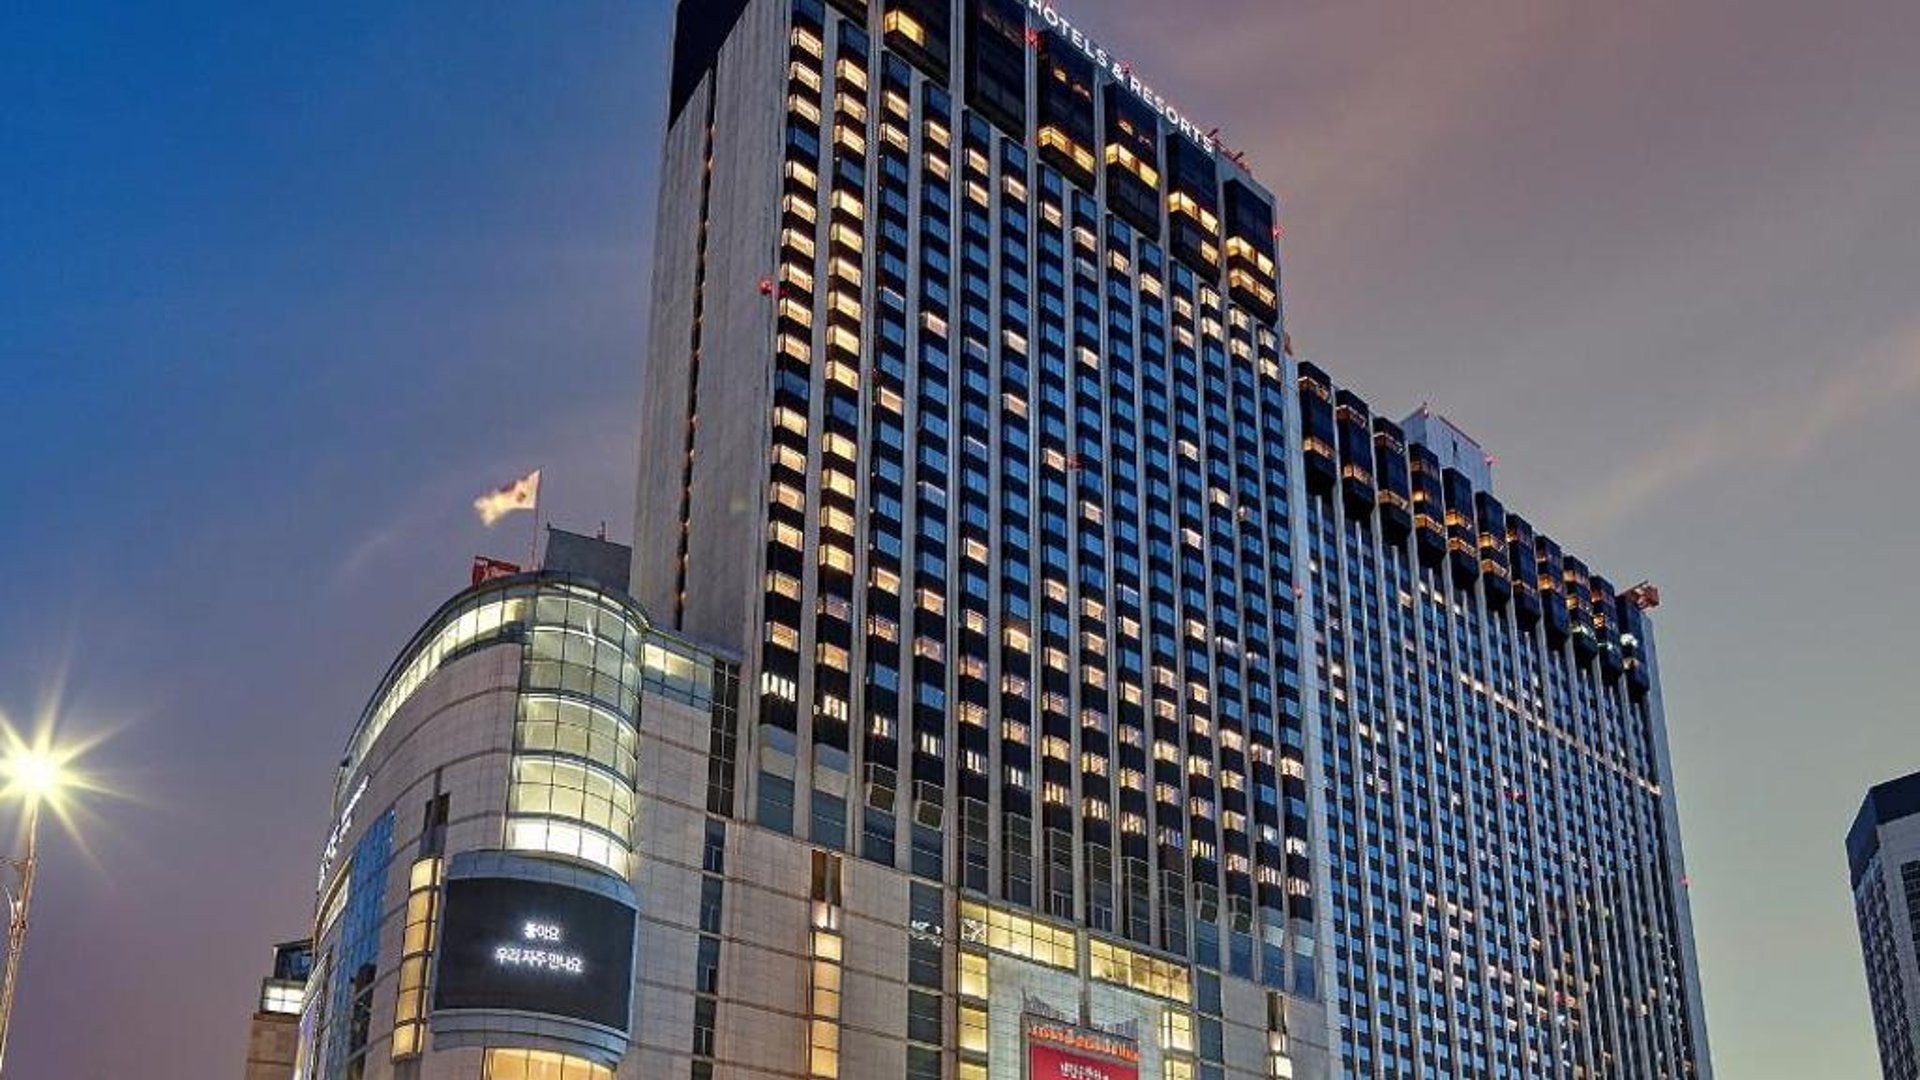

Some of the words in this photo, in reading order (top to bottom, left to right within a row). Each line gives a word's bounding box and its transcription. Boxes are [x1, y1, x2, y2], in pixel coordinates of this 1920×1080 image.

[1029, 0, 1108, 68] HOTELS
[1112, 63, 1124, 82] &
[1129, 75, 1213, 153] RESORTS
[496, 947, 520, 965] 우리
[521, 950, 547, 967] 자주
[549, 954, 583, 973] 만나요
